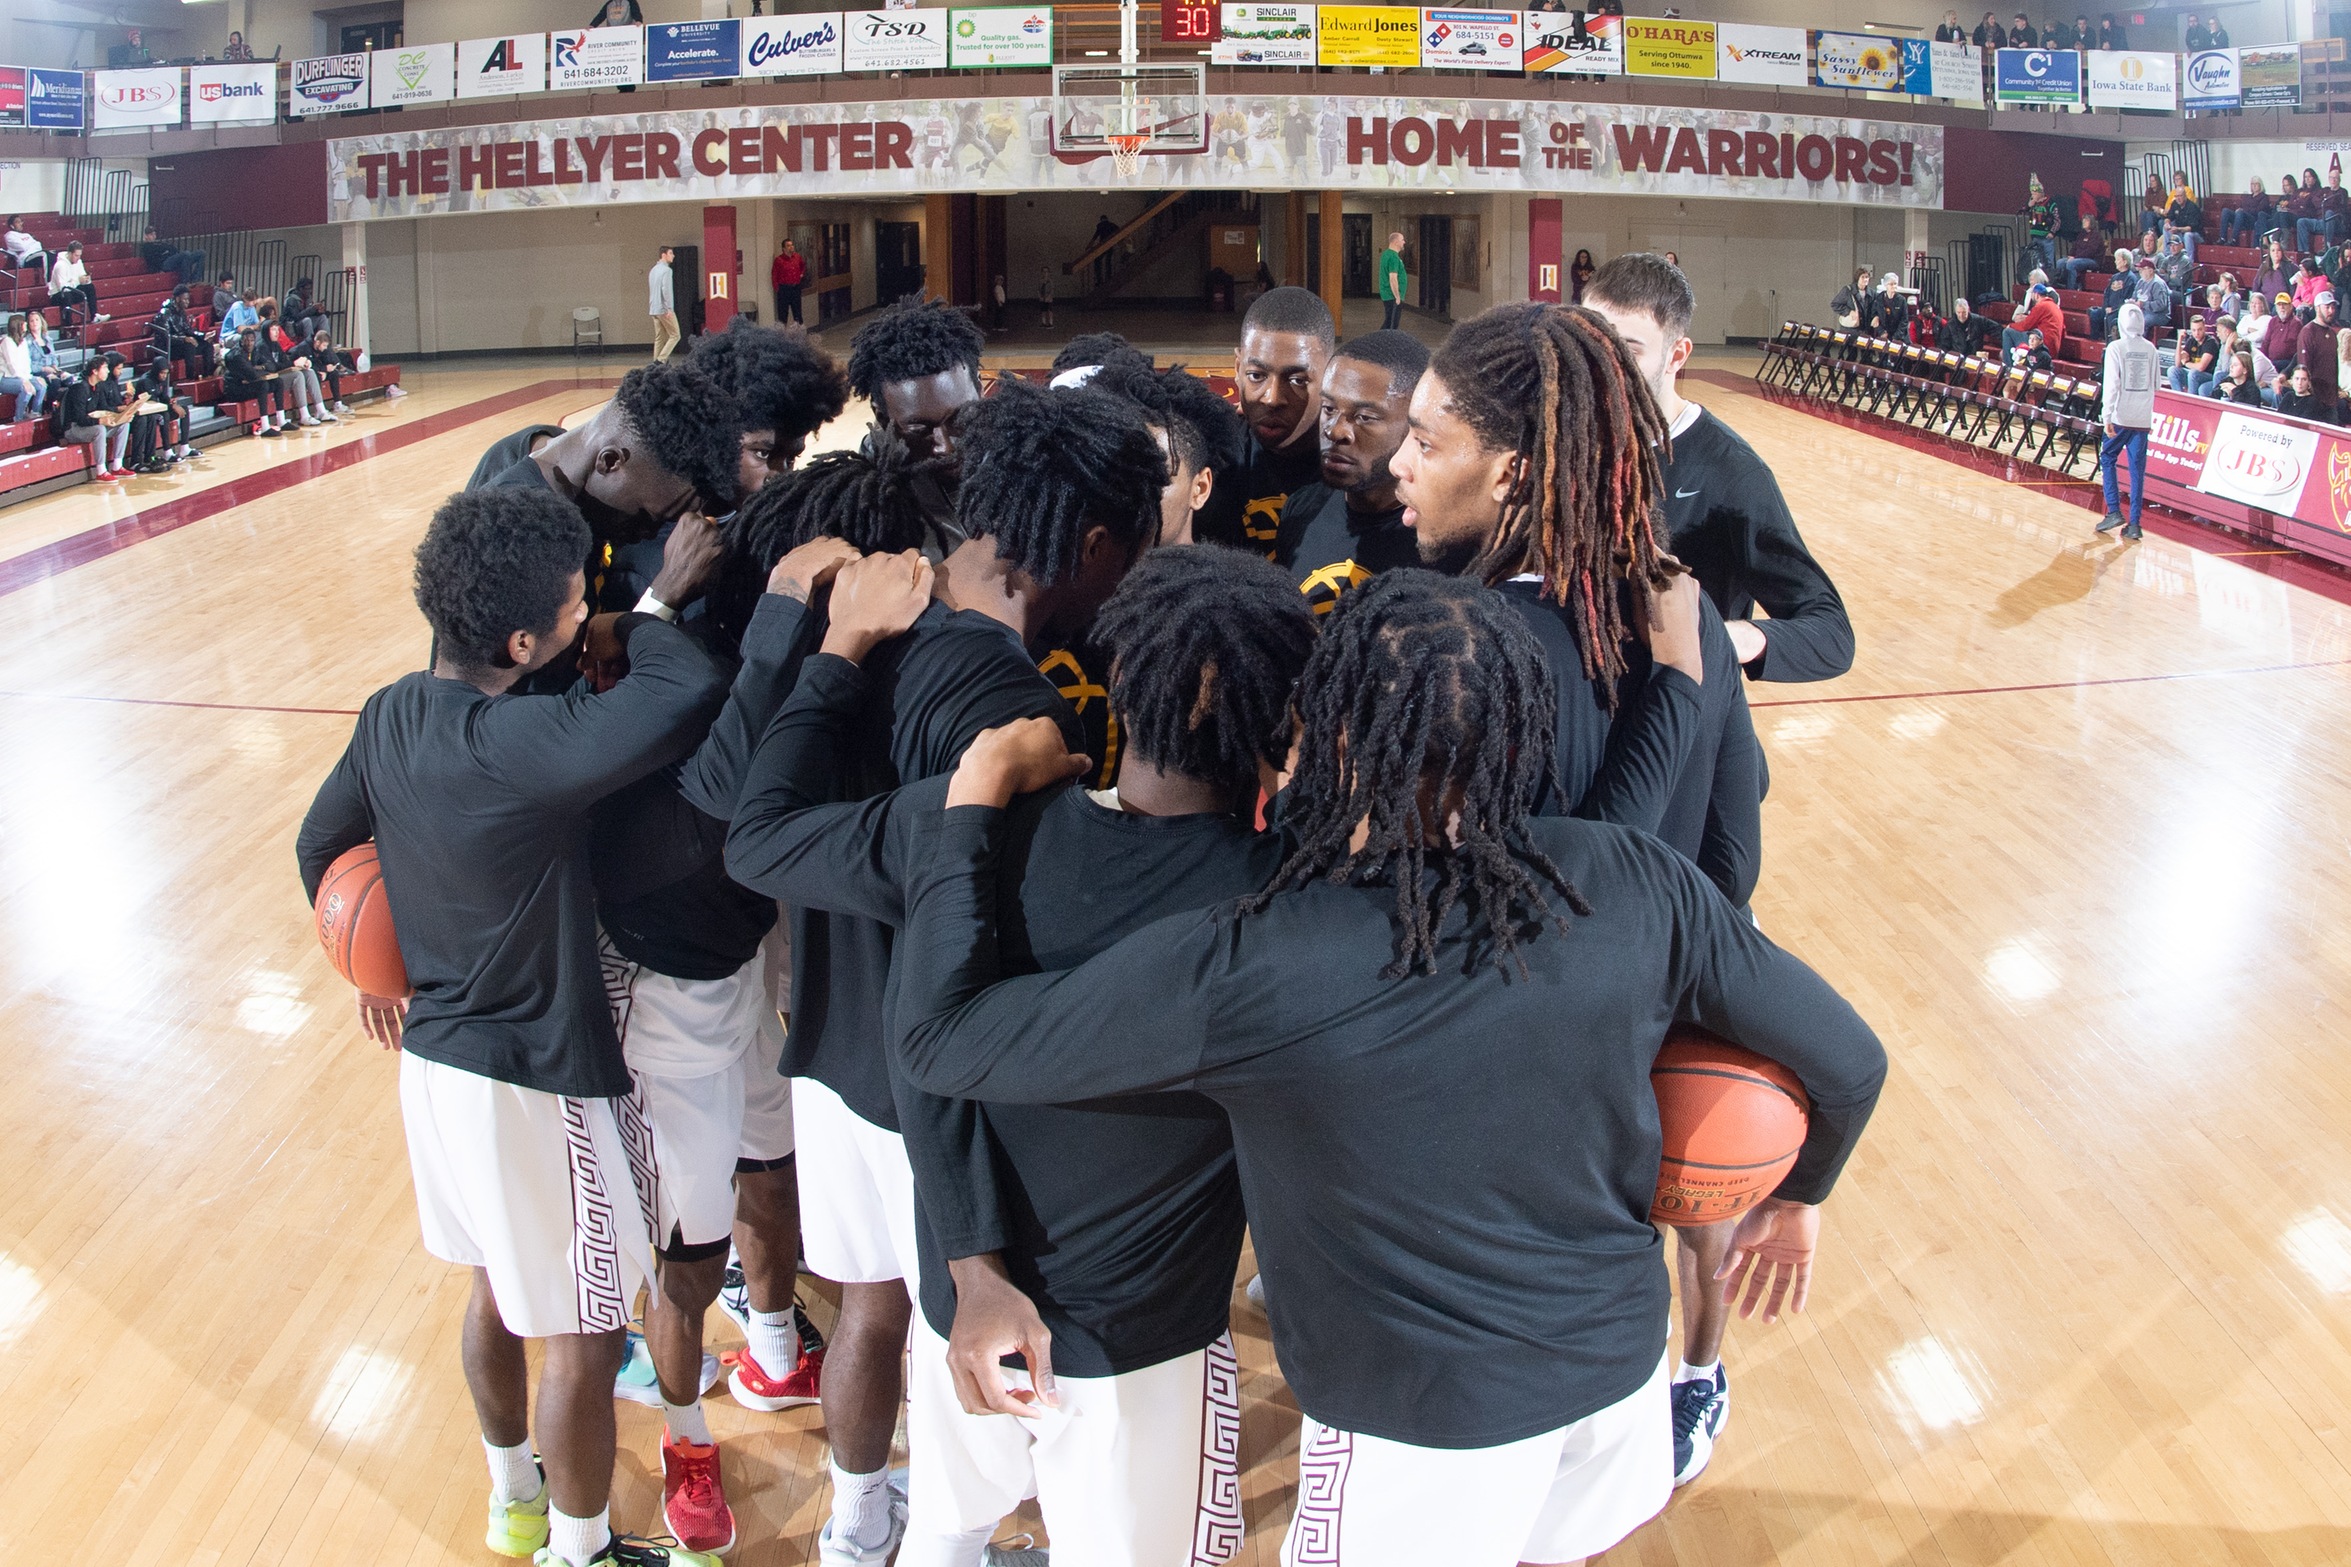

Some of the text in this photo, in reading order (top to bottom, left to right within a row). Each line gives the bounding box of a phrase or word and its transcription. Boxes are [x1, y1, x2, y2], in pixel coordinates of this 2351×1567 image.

[1256, 8, 1296, 16] SINCLAIR
[681, 24, 720, 32] BELLEVUE
[1177, 8, 1209, 36] 30
[1320, 17, 1417, 33] Edward Jones
[865, 22, 926, 36] TSD
[1626, 26, 1714, 45] O'HARA'S
[1456, 32, 1494, 40] 684-5151
[1540, 34, 1612, 51] IDEAL
[748, 22, 836, 67] Culver's
[398, 51, 426, 66] DC
[480, 39, 523, 73] AL
[668, 49, 719, 59] Accelerate.
[1639, 50, 1703, 60] Serving Ottumwa
[1744, 49, 1801, 60] XTREAM
[1824, 54, 1856, 64] Sassy
[296, 54, 364, 86] DURFLINGER
[564, 66, 628, 79] 641-684-3202
[1832, 64, 1895, 77] Sunflower
[2194, 60, 2230, 82] Vaughn
[560, 77, 632, 86] RIVERCOMMUNITYCU.ORG
[2005, 78, 2034, 86] Community
[2093, 80, 2172, 92] Iowa State Bank
[2204, 82, 2229, 90] Automotive
[112, 86, 162, 104] JBS
[305, 83, 354, 95] EXCAVATING
[300, 102, 358, 114] 641.777.9666
[1347, 116, 1914, 186] HOME OF THE WARRIORS!
[358, 122, 914, 198] THE HELLYER CENTER
[2329, 152, 2342, 174] A
[2240, 425, 2293, 448] Powered by
[2195, 442, 2208, 454] TV
[2154, 451, 2165, 460] the
[2165, 454, 2179, 465] App
[2180, 457, 2204, 471] Today!
[2226, 450, 2285, 482] JBS
[1681, 1177, 1750, 1187] DEEP CHANNEL
[1661, 1185, 1726, 1198] LEGACY
